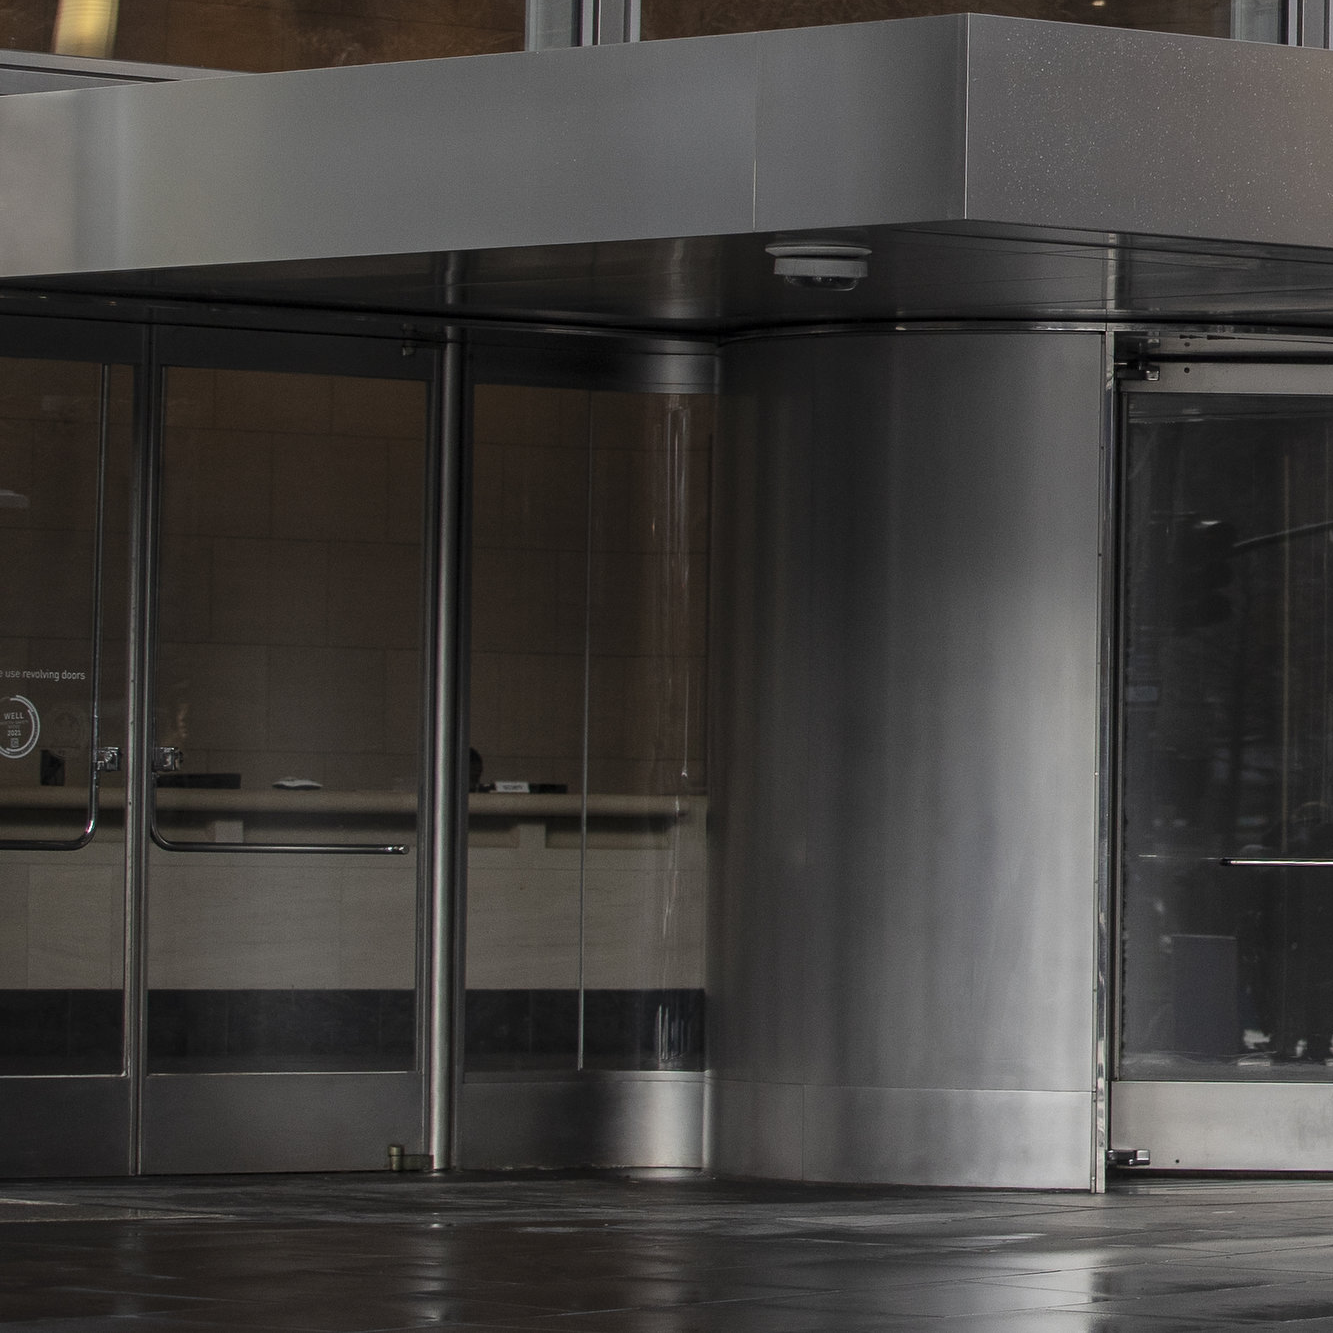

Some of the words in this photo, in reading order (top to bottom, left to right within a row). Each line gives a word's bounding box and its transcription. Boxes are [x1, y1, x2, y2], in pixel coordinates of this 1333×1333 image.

[5, 670, 20, 678] use
[22, 669, 60, 682] revolving
[61, 670, 86, 680] doors
[4, 712, 24, 720] WELL
